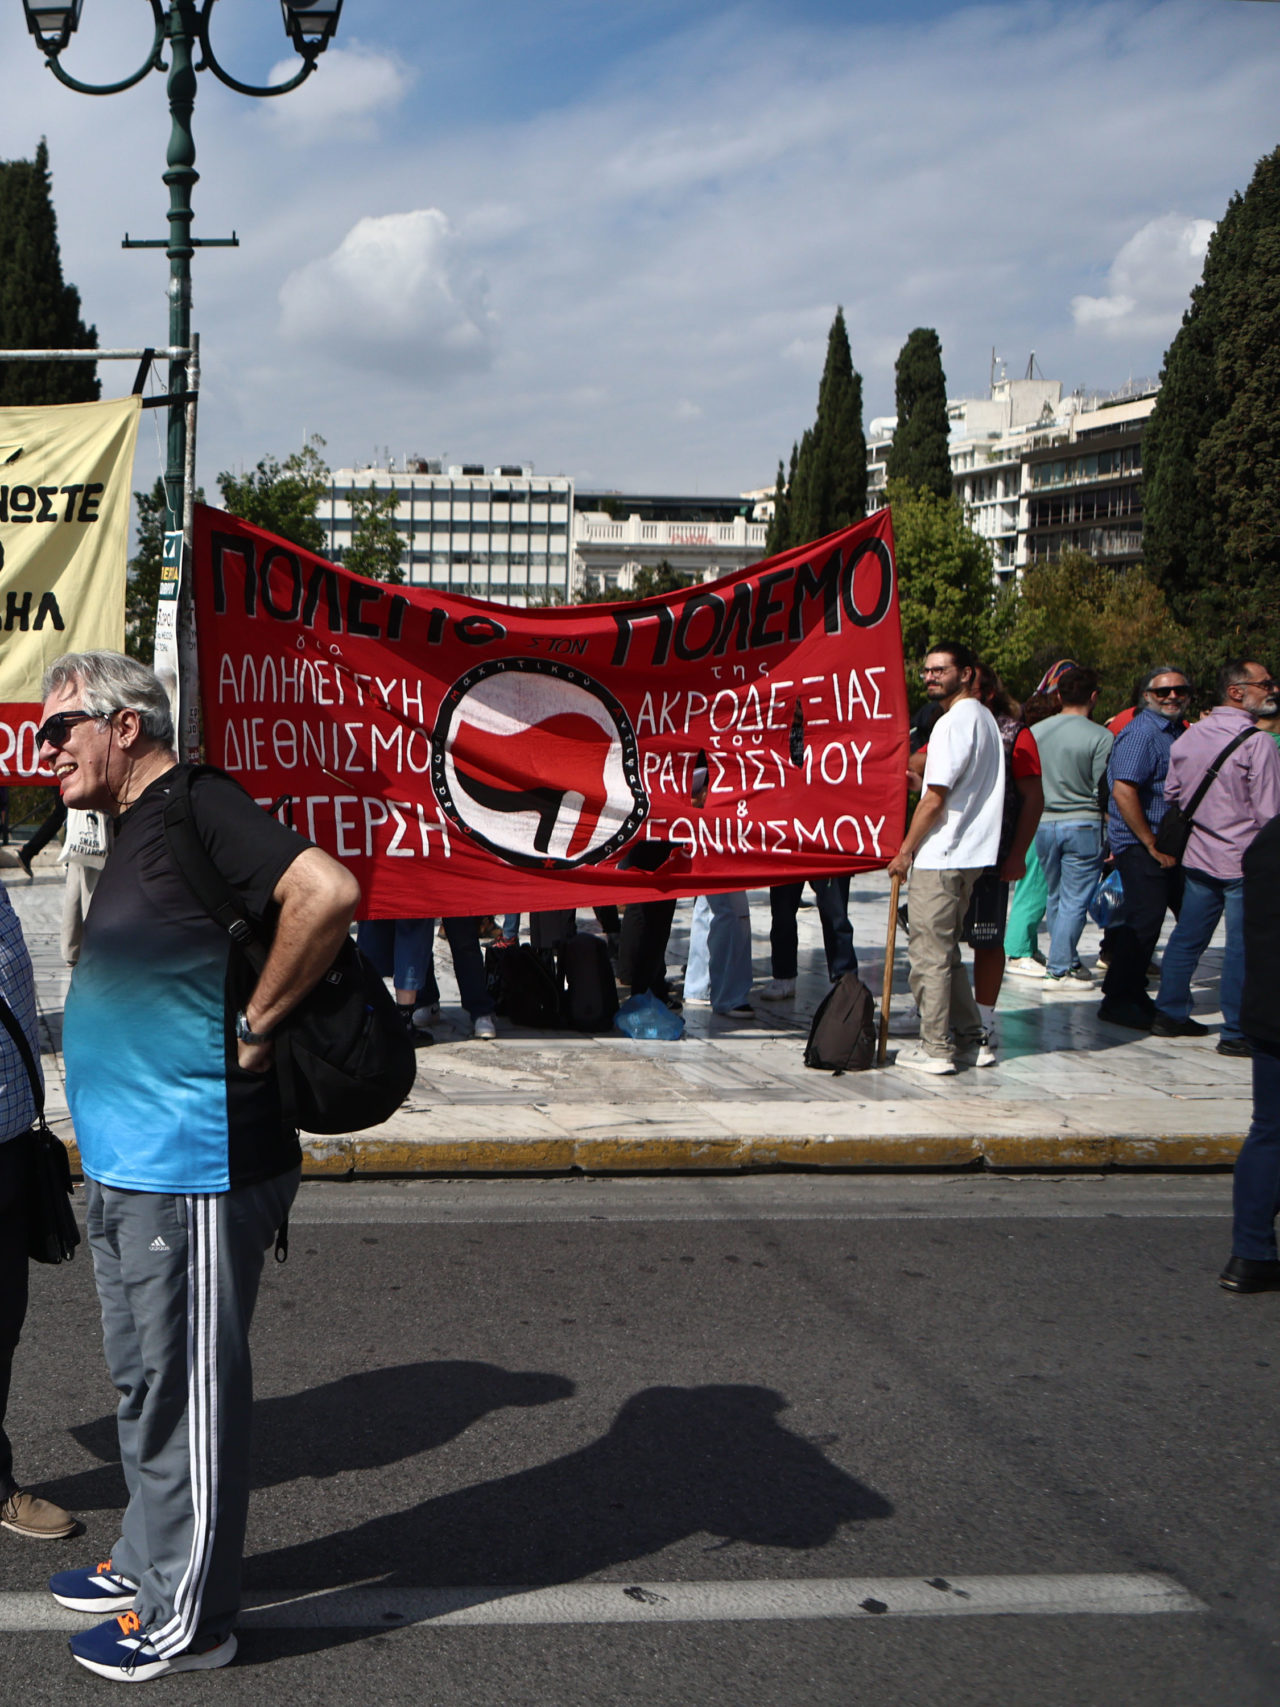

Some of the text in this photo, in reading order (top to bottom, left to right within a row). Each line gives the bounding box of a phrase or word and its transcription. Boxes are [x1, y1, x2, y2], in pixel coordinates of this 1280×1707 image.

[610, 537, 893, 666] ΠΟΛΕΜΟ
[219, 653, 424, 724] ΑΛΛΗΛΕΓΓΥΗ
[711, 662, 769, 681] της
[636, 667, 892, 735] ΑΚΡΟΔΕΞΙΑΣ
[224, 718, 431, 773] ΔΙΕΘΝΙΣΜΟ
[644, 741, 871, 794] ΡΑΤΣΙΣΜΟΥ
[709, 735, 763, 749] του
[736, 799, 749, 817] &
